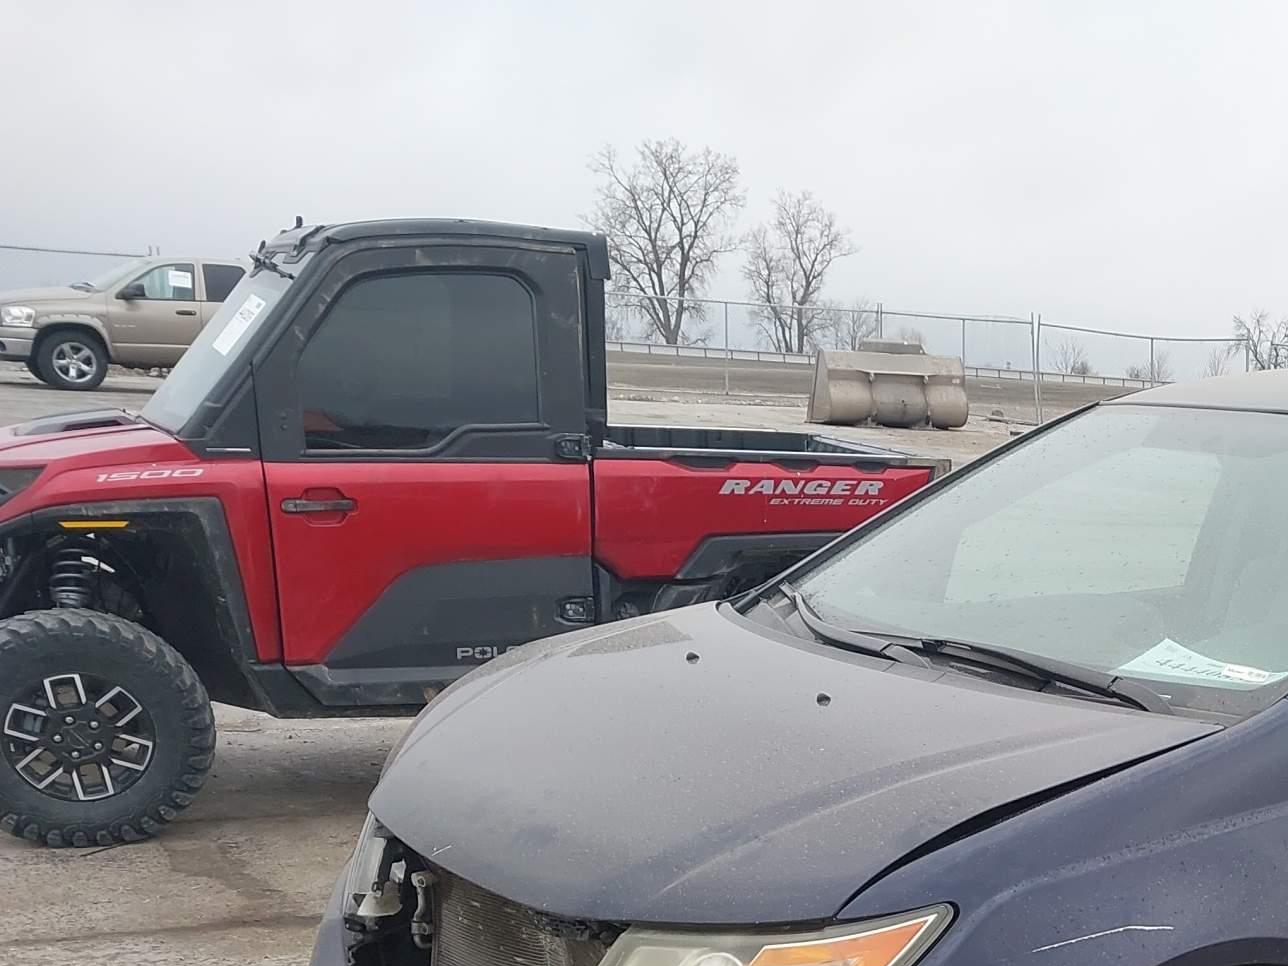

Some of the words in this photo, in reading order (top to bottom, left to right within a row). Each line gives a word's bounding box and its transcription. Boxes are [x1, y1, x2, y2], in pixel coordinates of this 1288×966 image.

[96, 468, 204, 482] 1500
[718, 479, 885, 496] RANGER
[768, 497, 844, 506] EXTREME
[847, 498, 889, 506] DUTY
